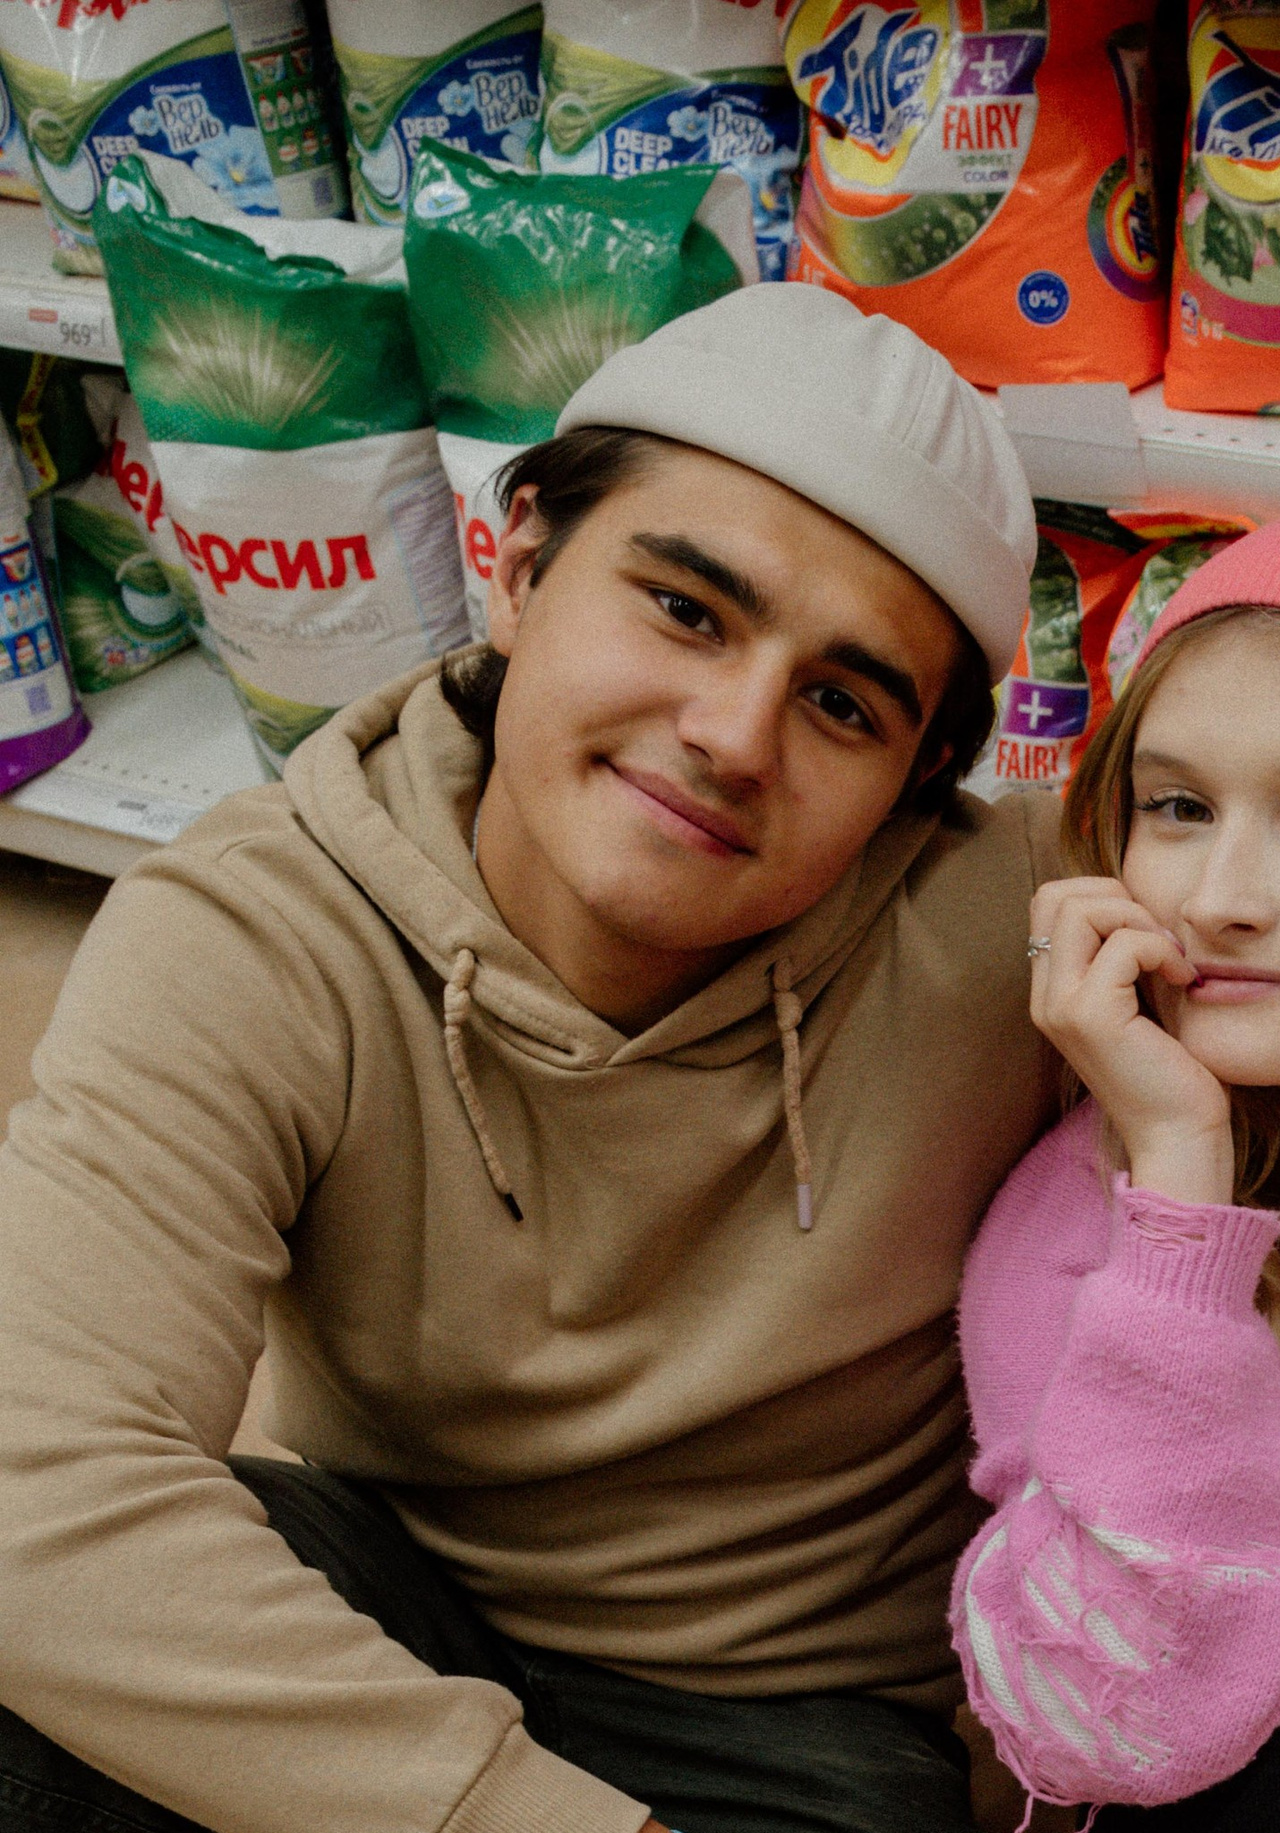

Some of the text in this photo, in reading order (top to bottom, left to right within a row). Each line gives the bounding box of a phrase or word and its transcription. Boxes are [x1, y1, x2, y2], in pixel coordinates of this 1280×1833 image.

[799, 10, 938, 134] Tide
[401, 116, 450, 140] DEEP
[942, 102, 1022, 150] FAIRY
[614, 127, 674, 157] DEEP
[1028, 289, 1059, 308] 0%
[60, 321, 92, 347] 969
